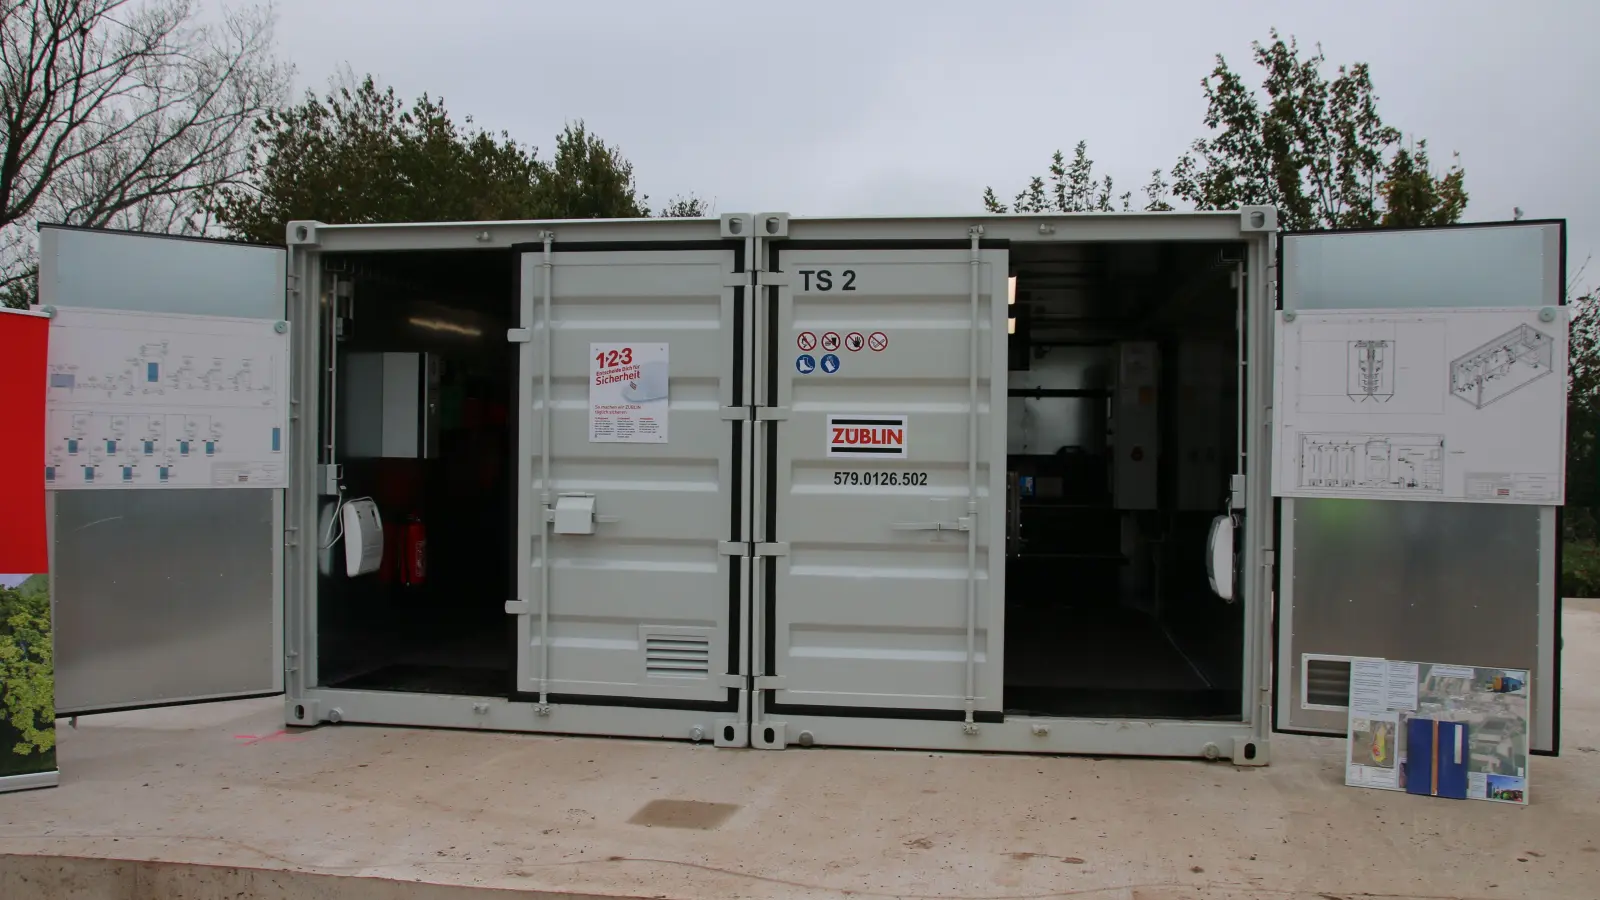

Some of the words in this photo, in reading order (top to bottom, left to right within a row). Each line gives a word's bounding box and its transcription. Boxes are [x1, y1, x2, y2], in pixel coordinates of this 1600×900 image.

[799, 270, 832, 291] TS
[842, 269, 856, 291] 2
[596, 370, 640, 385] Sicherheit
[832, 428, 902, 445] ZÜBLIN
[834, 472, 928, 486] 579.0126.502
